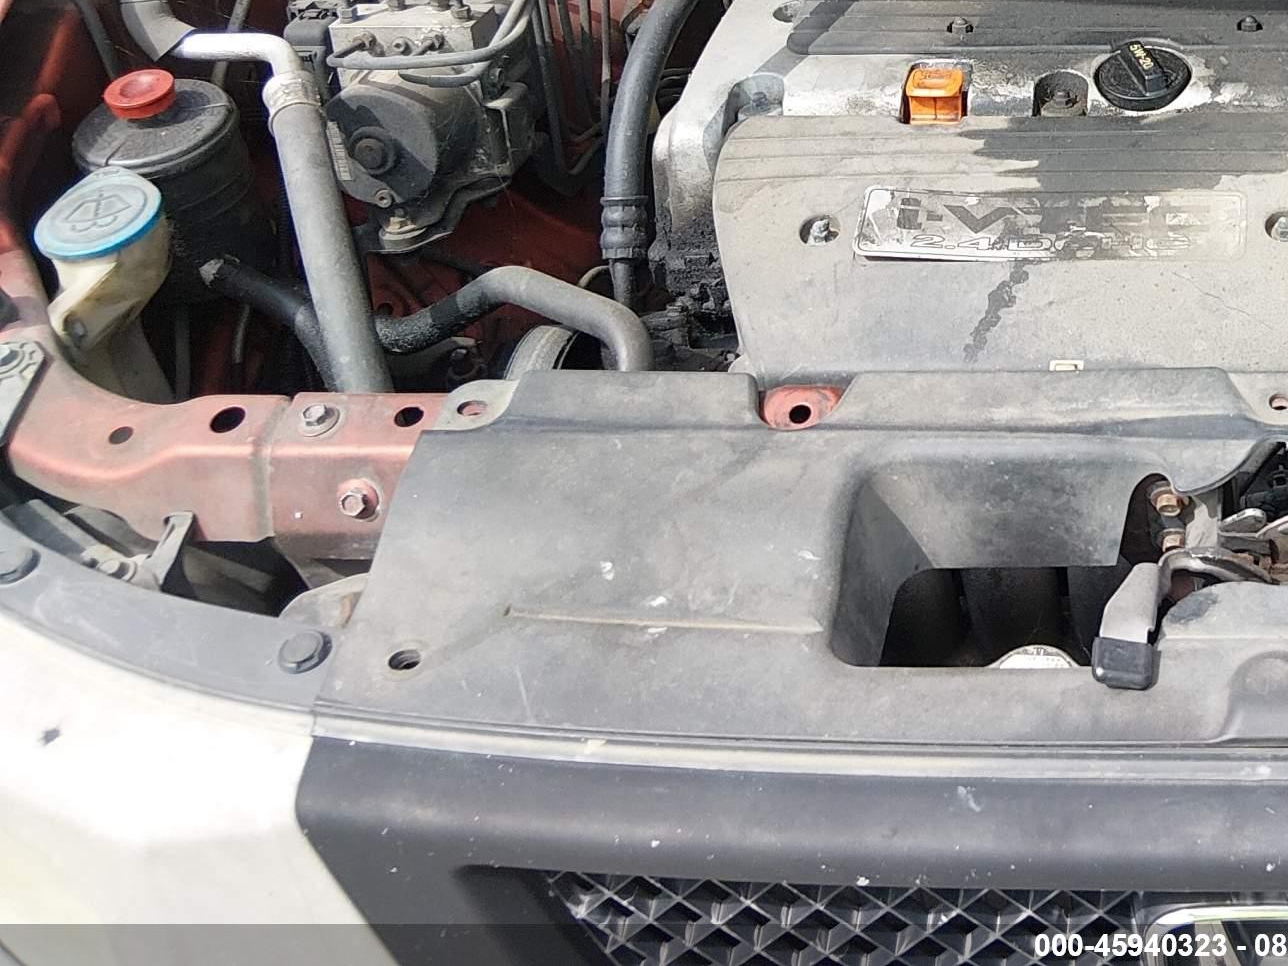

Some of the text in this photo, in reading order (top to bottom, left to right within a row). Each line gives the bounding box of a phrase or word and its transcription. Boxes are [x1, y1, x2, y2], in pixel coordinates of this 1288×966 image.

[1129, 44, 1154, 71] 5W-20
[911, 234, 1190, 252] 2.4 DHC
